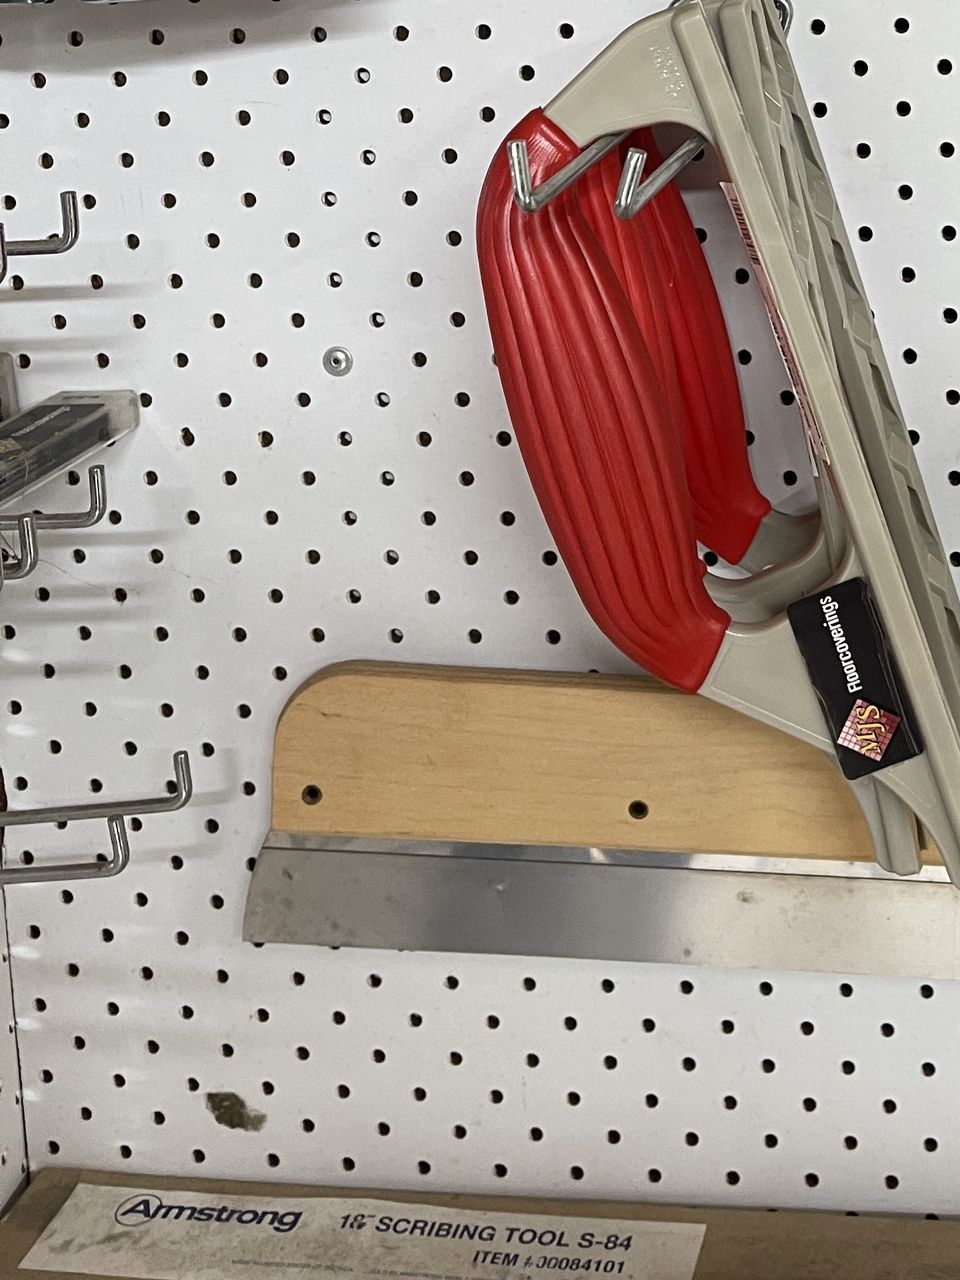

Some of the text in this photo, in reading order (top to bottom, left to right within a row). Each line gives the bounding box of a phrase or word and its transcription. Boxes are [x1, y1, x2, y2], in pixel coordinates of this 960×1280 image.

[820, 596, 863, 693] Floorcoverings
[855, 704, 887, 755] MJS
[117, 1197, 304, 1233] Armstrong
[375, 1216, 498, 1242] SCRIBING
[505, 1227, 570, 1248] TOOL
[577, 1232, 633, 1252] S-84
[472, 1250, 519, 1268] ITEM
